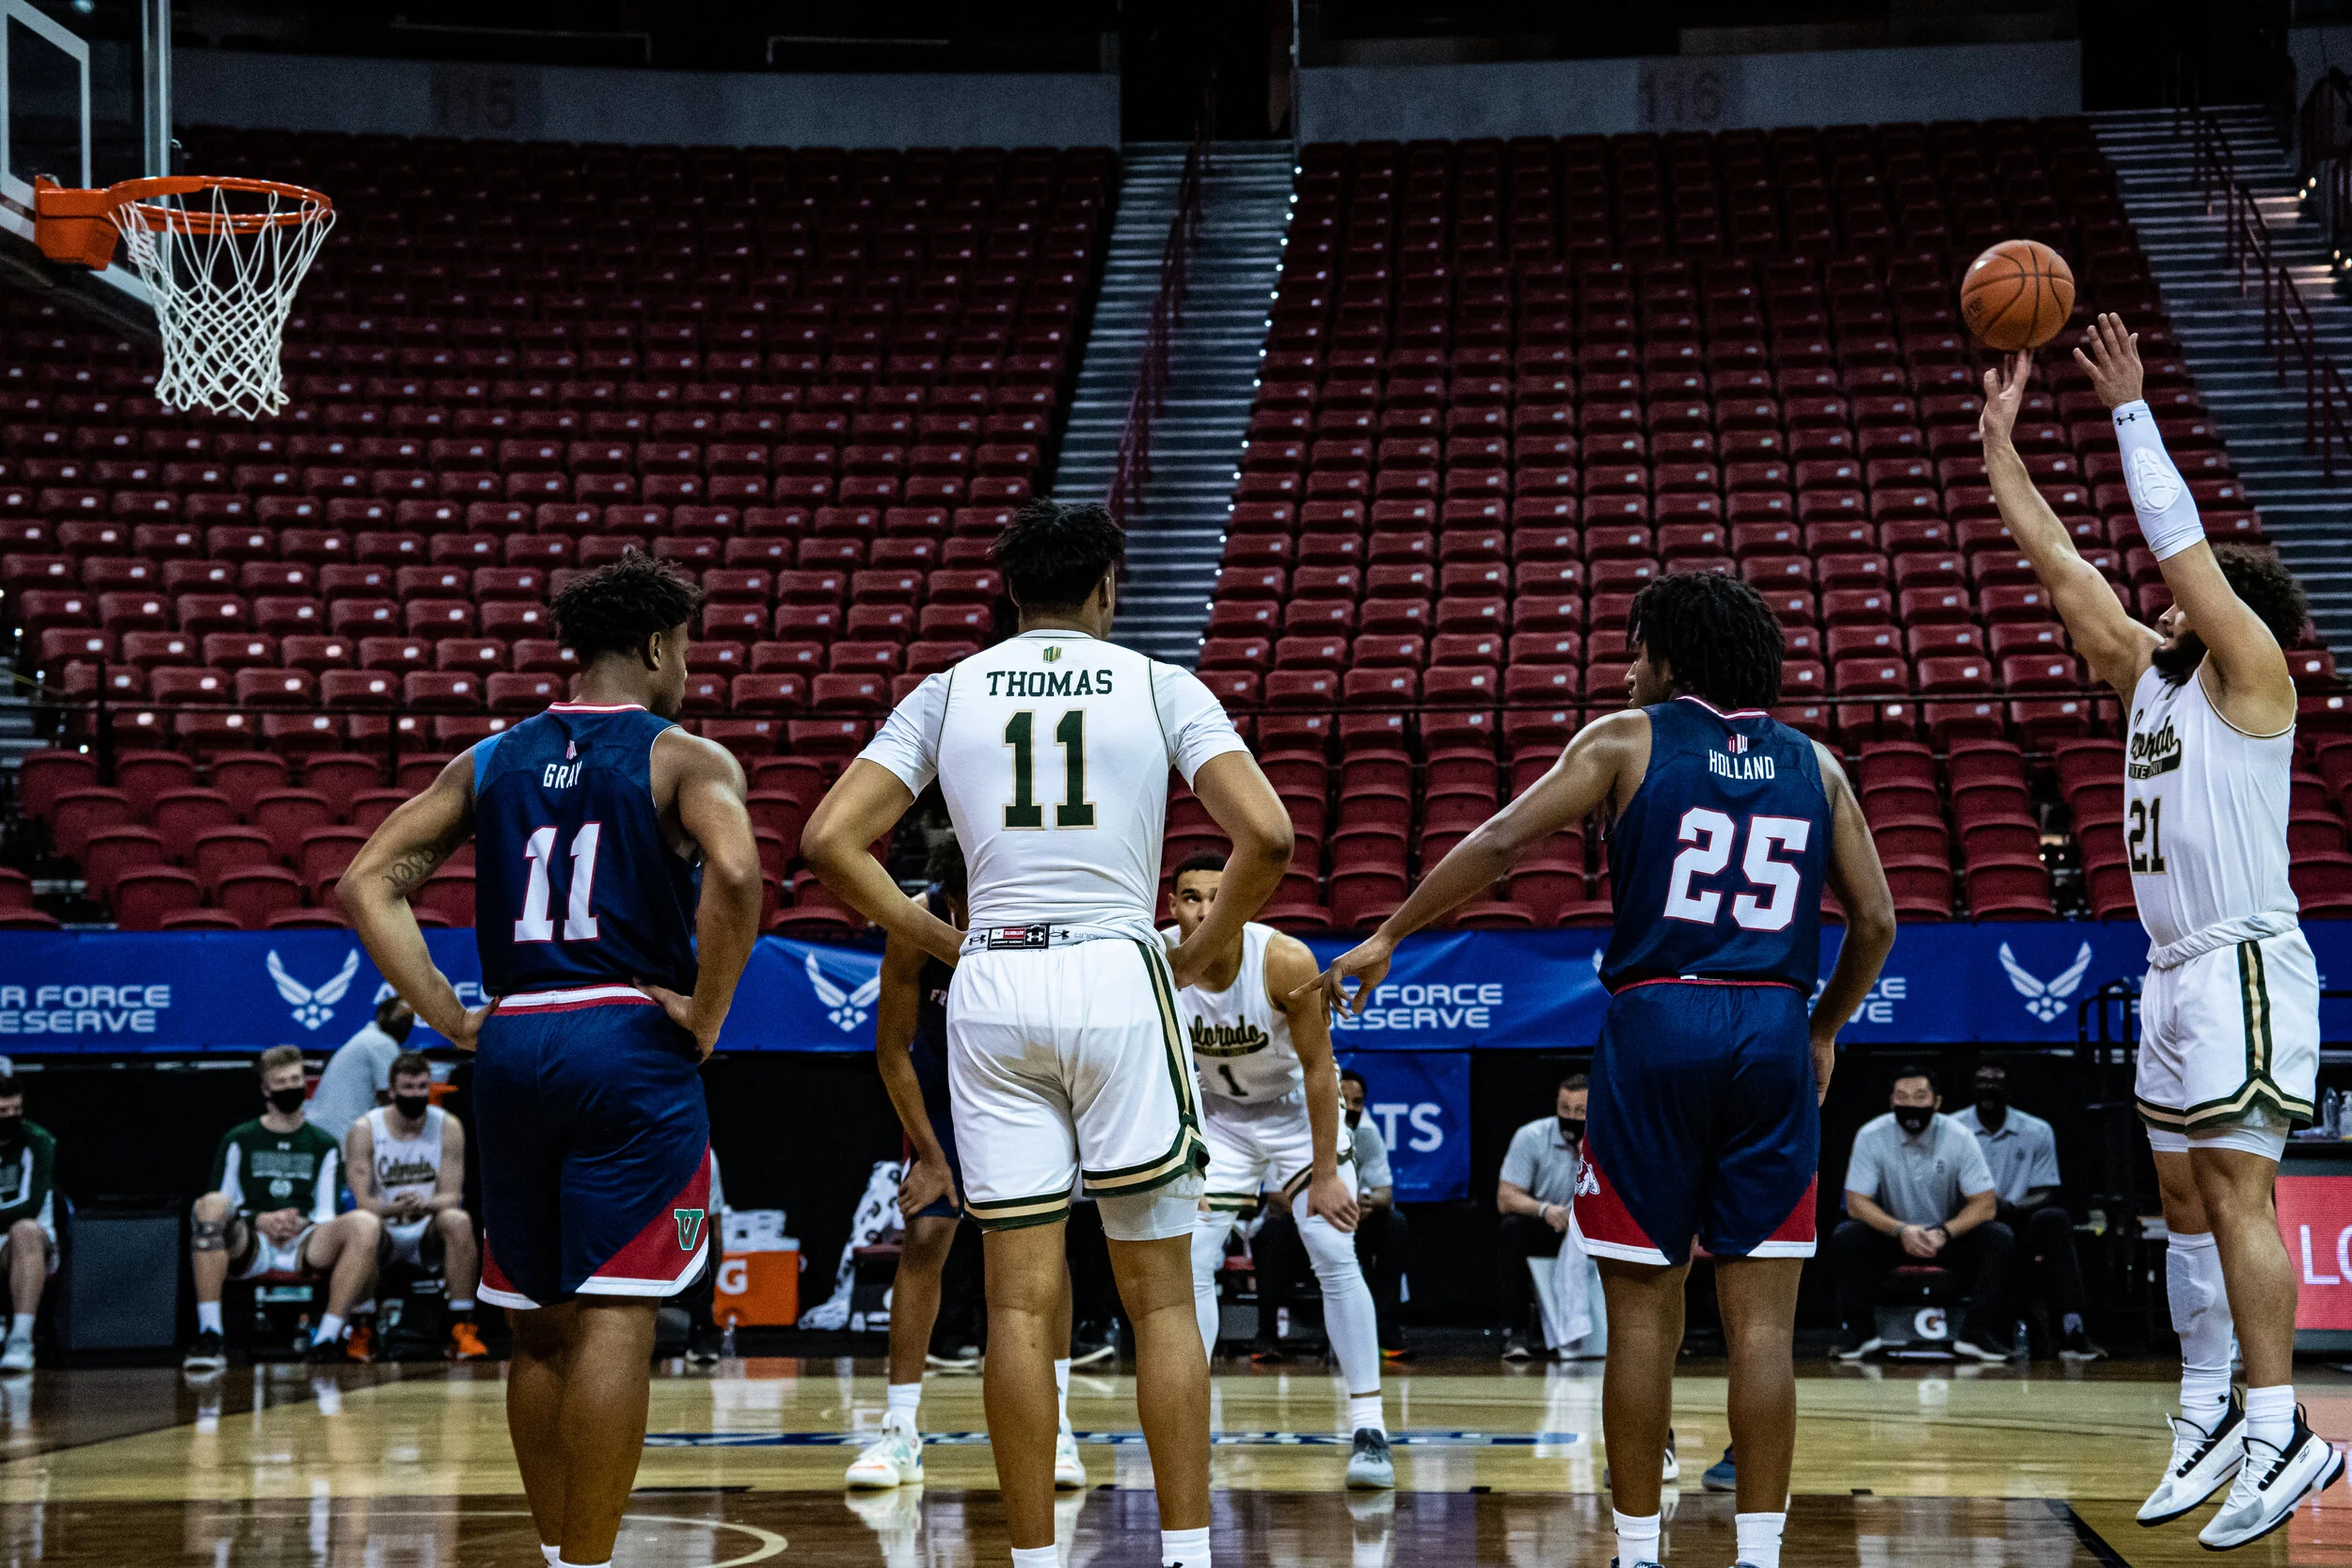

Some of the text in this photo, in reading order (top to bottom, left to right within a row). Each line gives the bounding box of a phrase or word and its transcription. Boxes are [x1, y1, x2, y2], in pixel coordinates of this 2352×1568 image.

[987, 669, 1114, 697] THOMAS
[543, 761, 582, 788] GRAY
[1002, 707, 1097, 831] 11
[1708, 749, 1775, 780] HOLLAND
[2128, 796, 2167, 875] 21
[514, 821, 601, 942] 11
[1663, 806, 1812, 931] 25
[36, 984, 170, 1008] FORCE
[1375, 983, 1502, 1006] FORCE
[1189, 1015, 1259, 1046] lorado
[1329, 1007, 1489, 1031] ESERVE
[1217, 1064, 1248, 1097] 1
[716, 1259, 747, 1295] G
[1915, 1307, 1947, 1339] G
